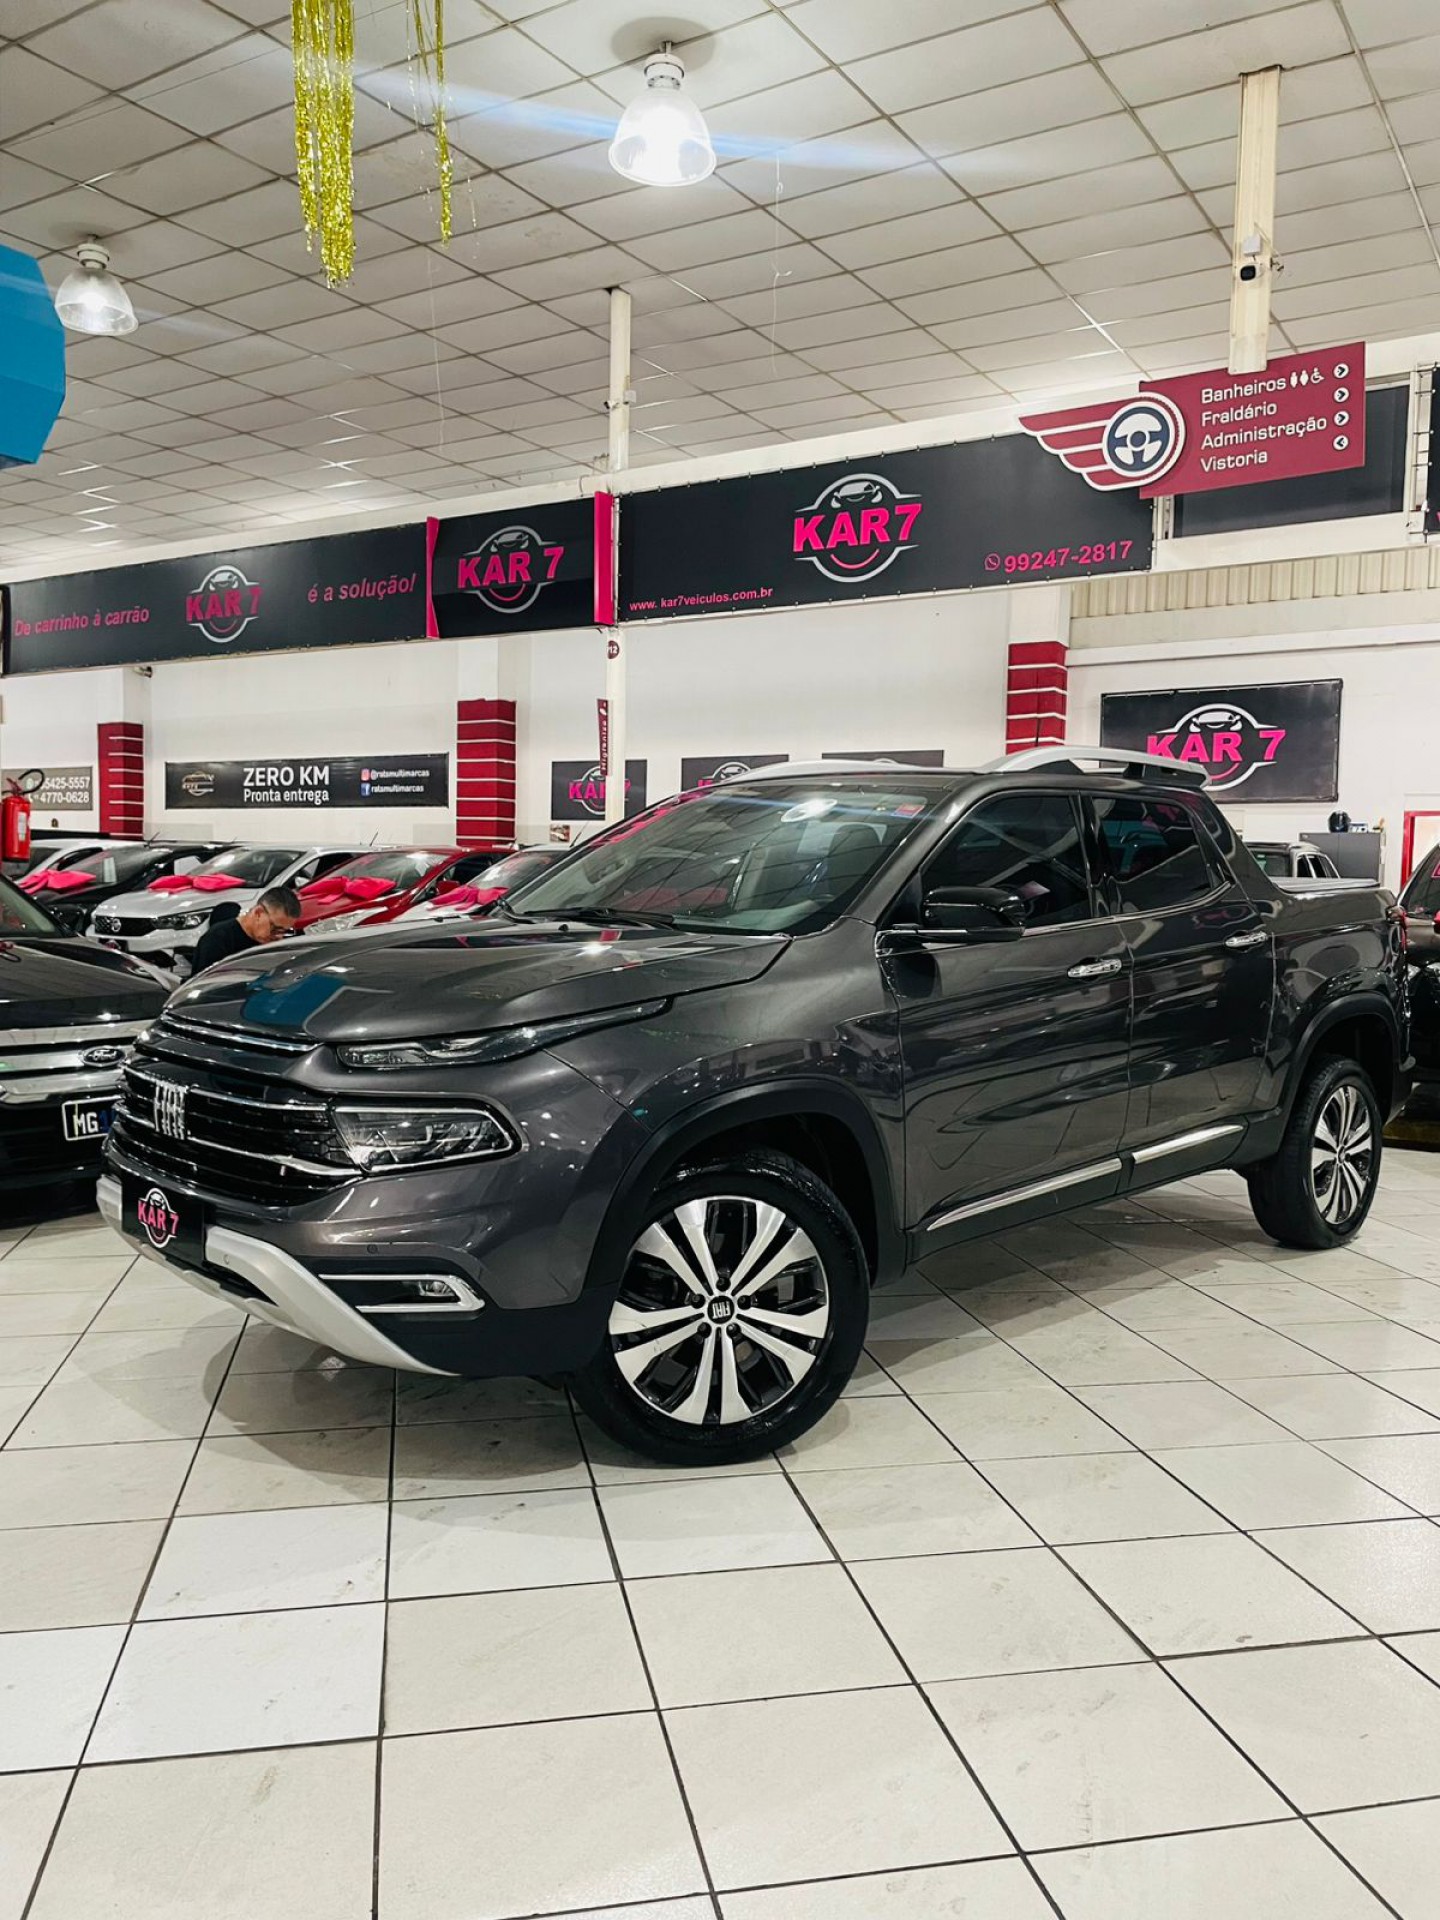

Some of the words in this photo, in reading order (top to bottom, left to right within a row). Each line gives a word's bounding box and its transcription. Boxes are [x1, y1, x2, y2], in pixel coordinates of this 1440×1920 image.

[1201, 377, 1287, 404] Banheiros
[1201, 401, 1277, 427] Fraldário
[1200, 415, 1327, 450] Administração
[1200, 450, 1268, 472] Vistoria
[794, 507, 891, 552] KAR
[895, 504, 922, 540] 7
[458, 551, 532, 588] KAR
[543, 547, 564, 579] 7
[1004, 541, 1133, 572] 99247-2817
[308, 584, 318, 603] é
[324, 586, 334, 602] a
[339, 573, 417, 600] solução!
[629, 600, 657, 612] www.
[660, 587, 774, 608] kar7veiculos.com.br
[186, 590, 242, 622] KAR
[249, 587, 263, 614] 7
[15, 619, 30, 636] De
[35, 612, 89, 634] carrinho
[105, 606, 150, 625] carrão
[1147, 732, 1243, 764] KAR
[1259, 729, 1286, 761] 7
[41, 777, 90, 790] 5425-5557
[243, 767, 294, 787] ZERO
[300, 766, 330, 785] KM
[570, 781, 605, 798] KA
[40, 791, 90, 804] 4770-0628
[244, 788, 281, 803] Pronta
[283, 788, 329, 805] entrega
[137, 1200, 166, 1231] KAR
[170, 1213, 180, 1235] 7
